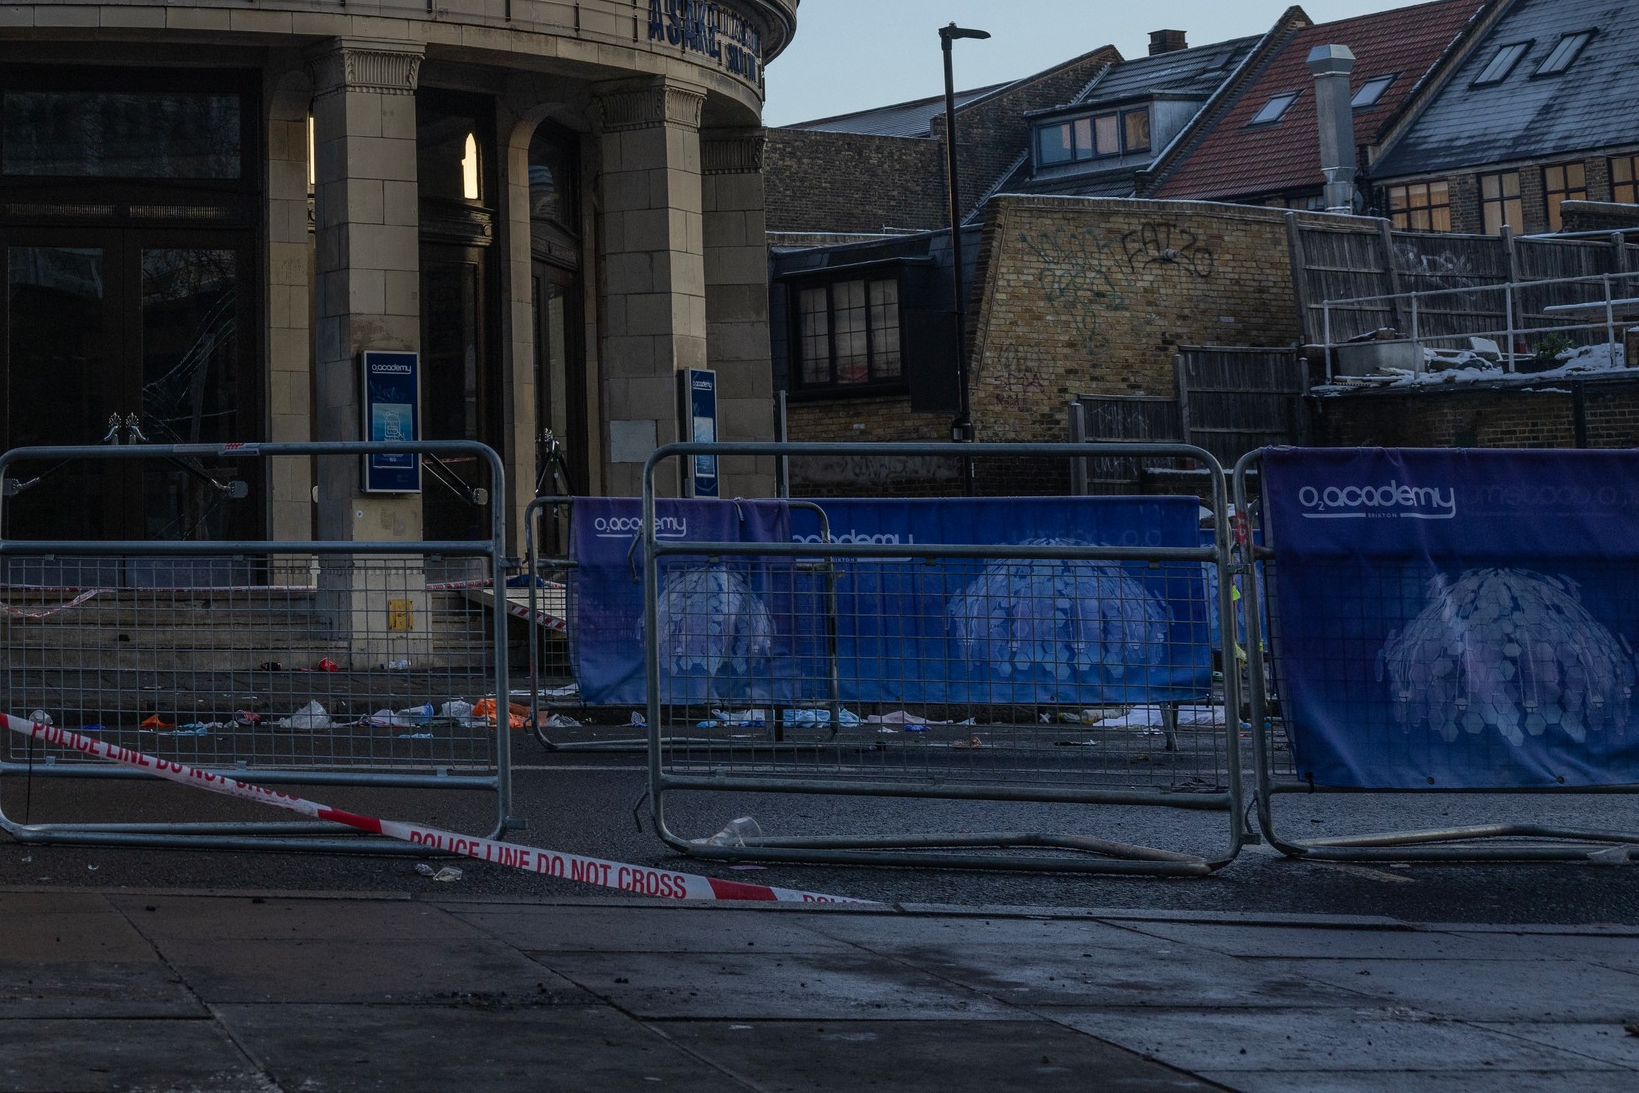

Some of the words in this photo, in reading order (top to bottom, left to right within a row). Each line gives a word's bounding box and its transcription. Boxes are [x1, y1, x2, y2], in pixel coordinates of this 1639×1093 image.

[1367, 511, 1398, 519] BRIXTON
[31, 720, 101, 755] POLICE
[536, 852, 564, 879] DO
[571, 858, 612, 888] NOT
[618, 866, 688, 900] CROSS
